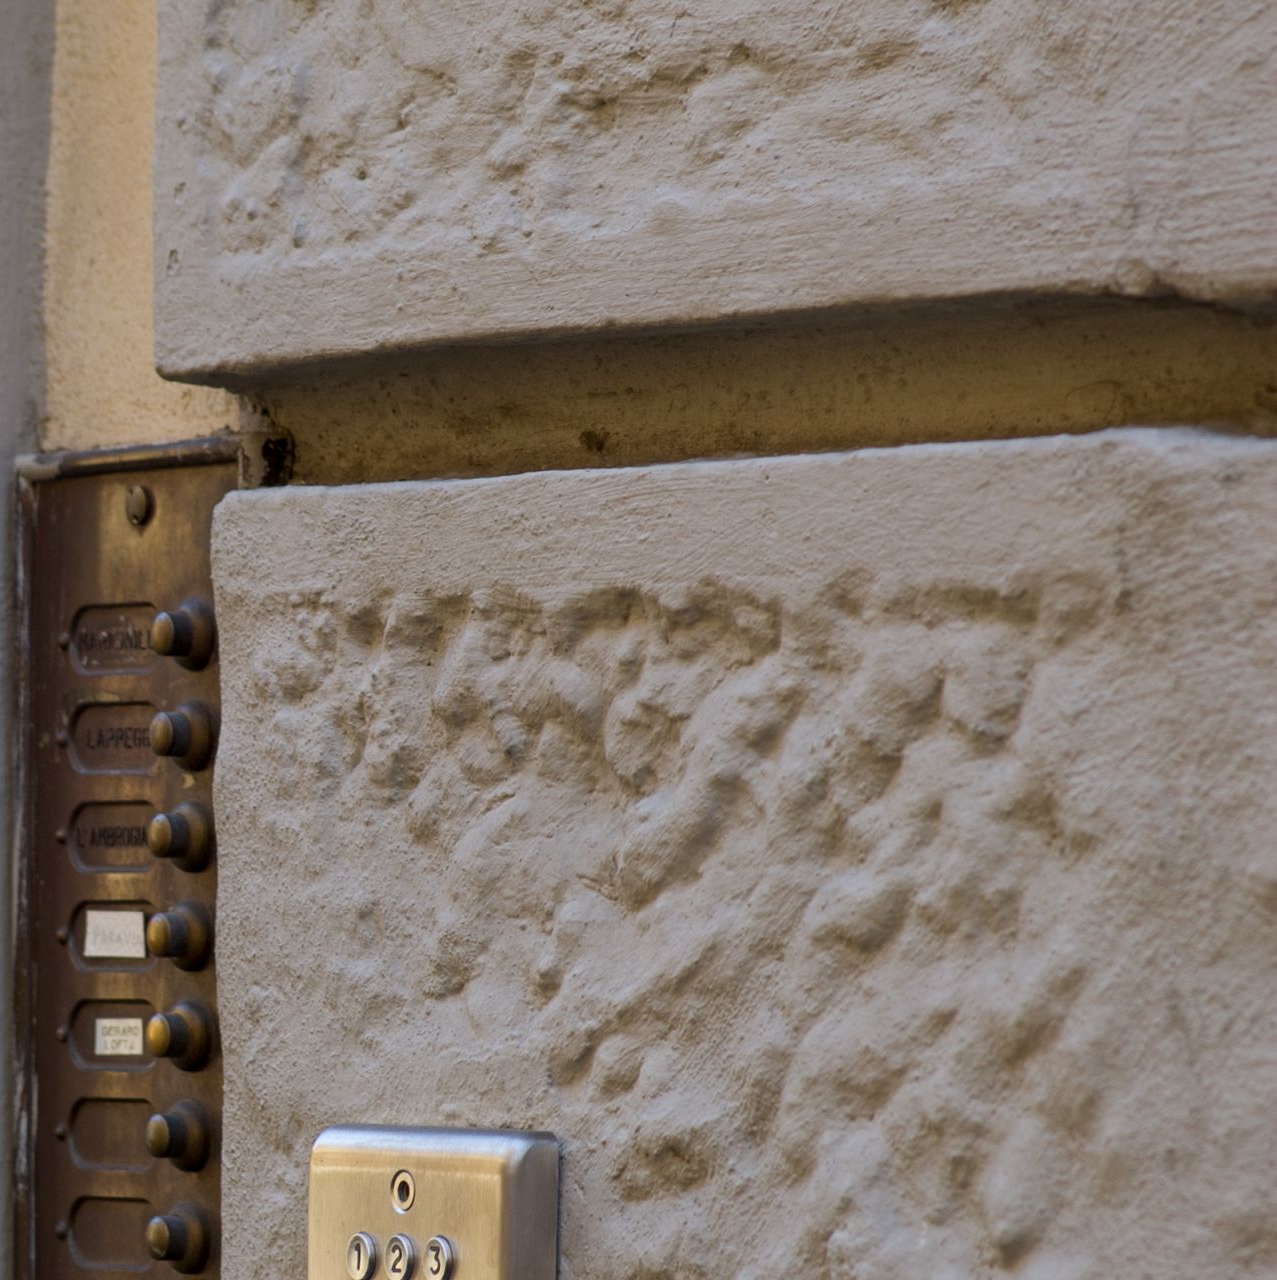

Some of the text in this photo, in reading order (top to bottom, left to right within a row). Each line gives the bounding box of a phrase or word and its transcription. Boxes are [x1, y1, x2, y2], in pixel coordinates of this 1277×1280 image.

[86, 726, 151, 751] LAPPEGG
[354, 1242, 441, 1276] 1 2 3
